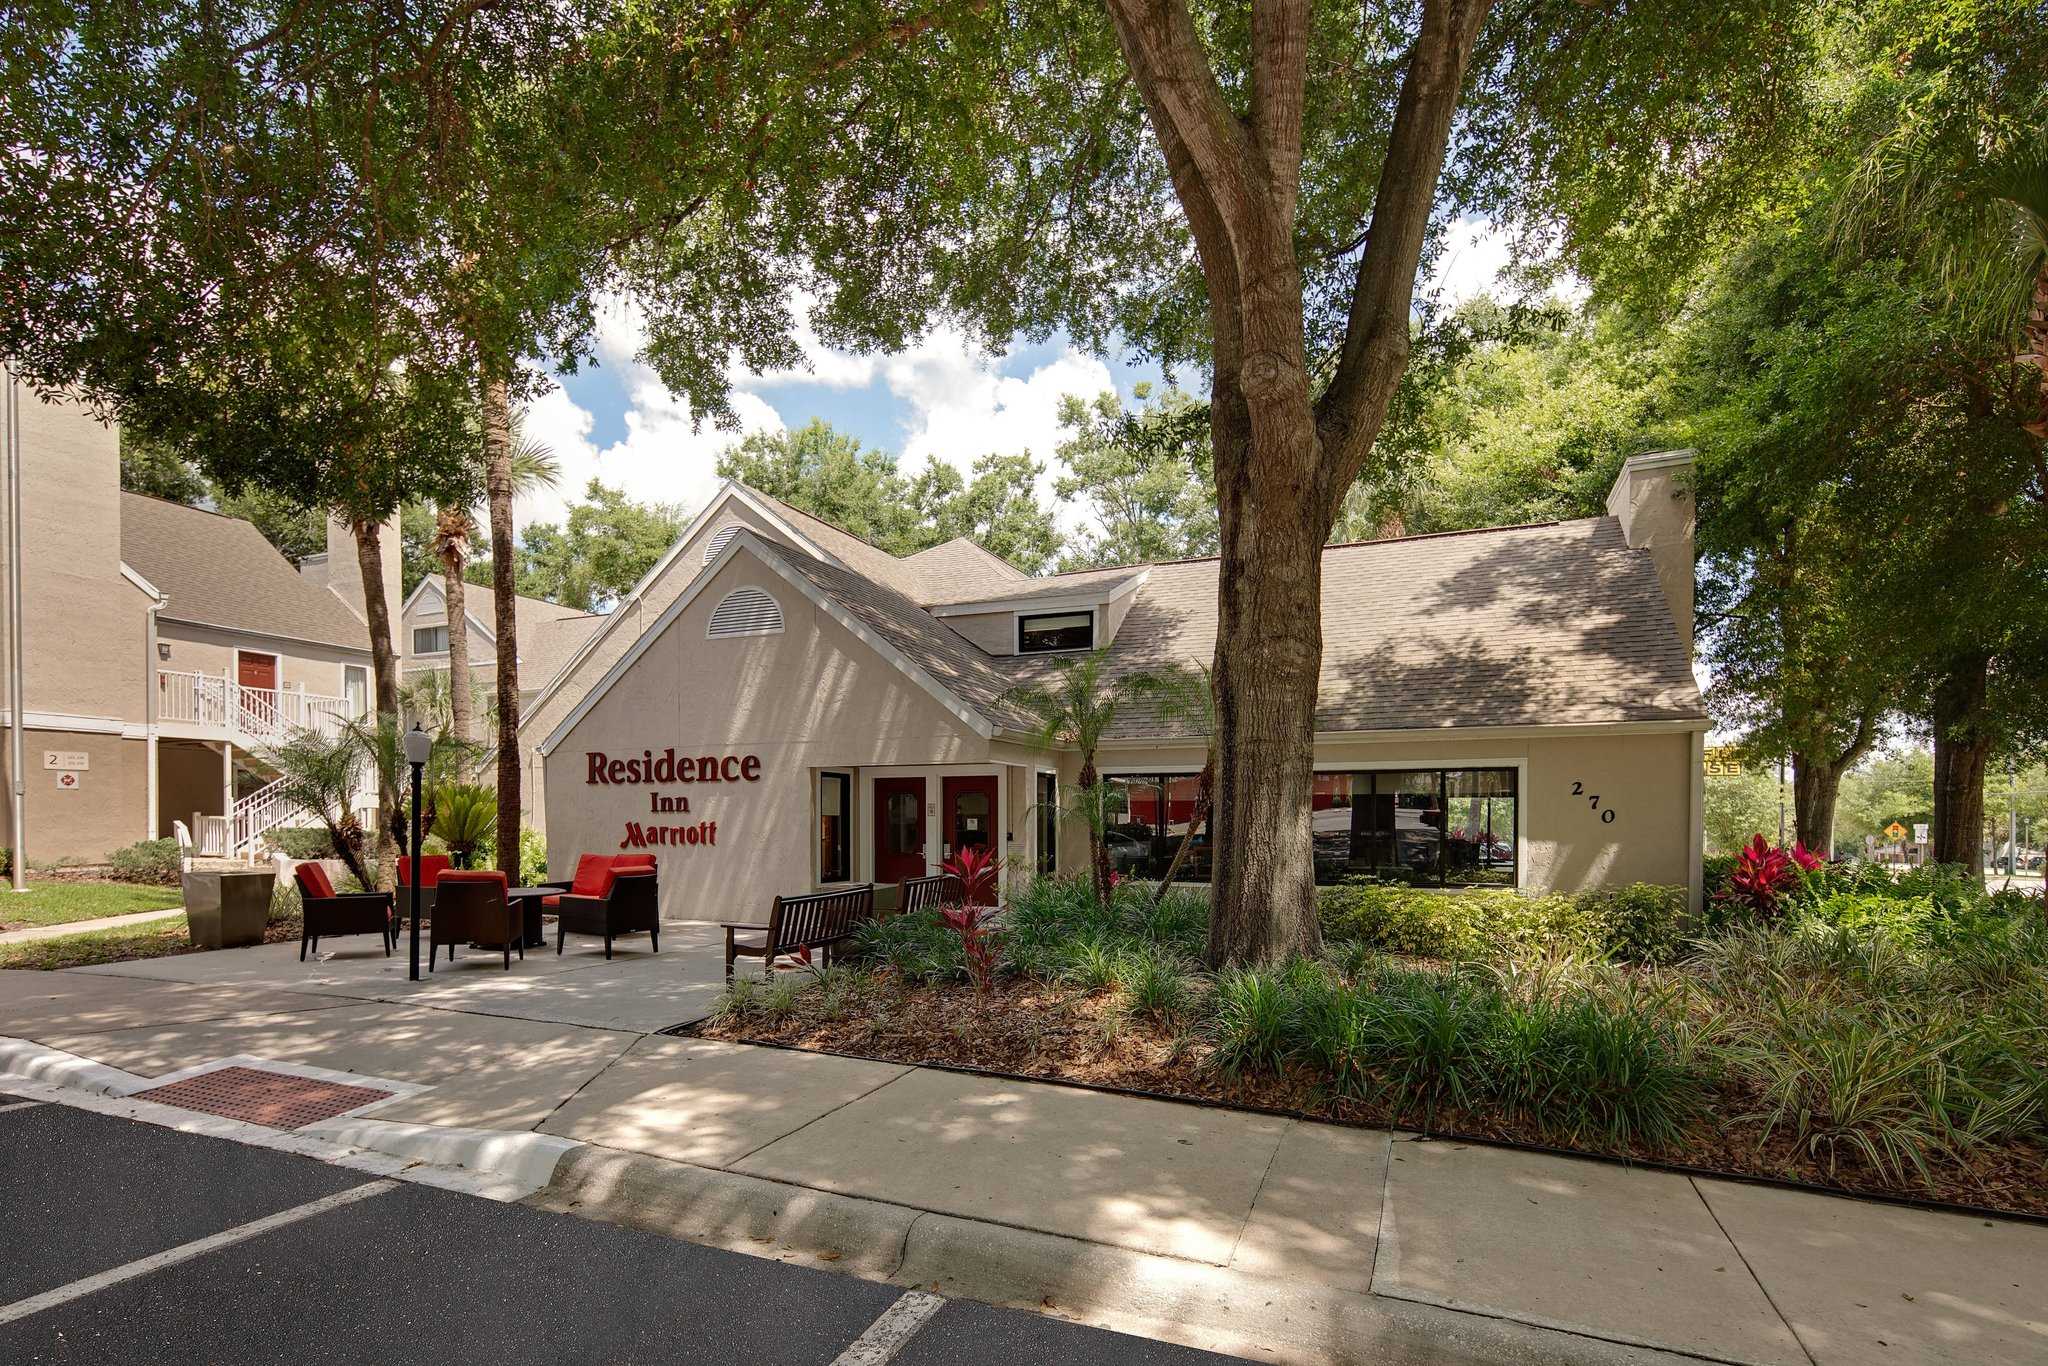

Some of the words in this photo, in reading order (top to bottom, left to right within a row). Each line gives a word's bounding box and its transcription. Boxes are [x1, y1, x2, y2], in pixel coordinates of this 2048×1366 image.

[48, 754, 58, 766] 2
[586, 748, 761, 785] Residence
[1707, 763, 1739, 774] SE
[650, 792, 690, 813] Inn
[1571, 781, 1616, 824] 270
[620, 821, 717, 848] Marriott
